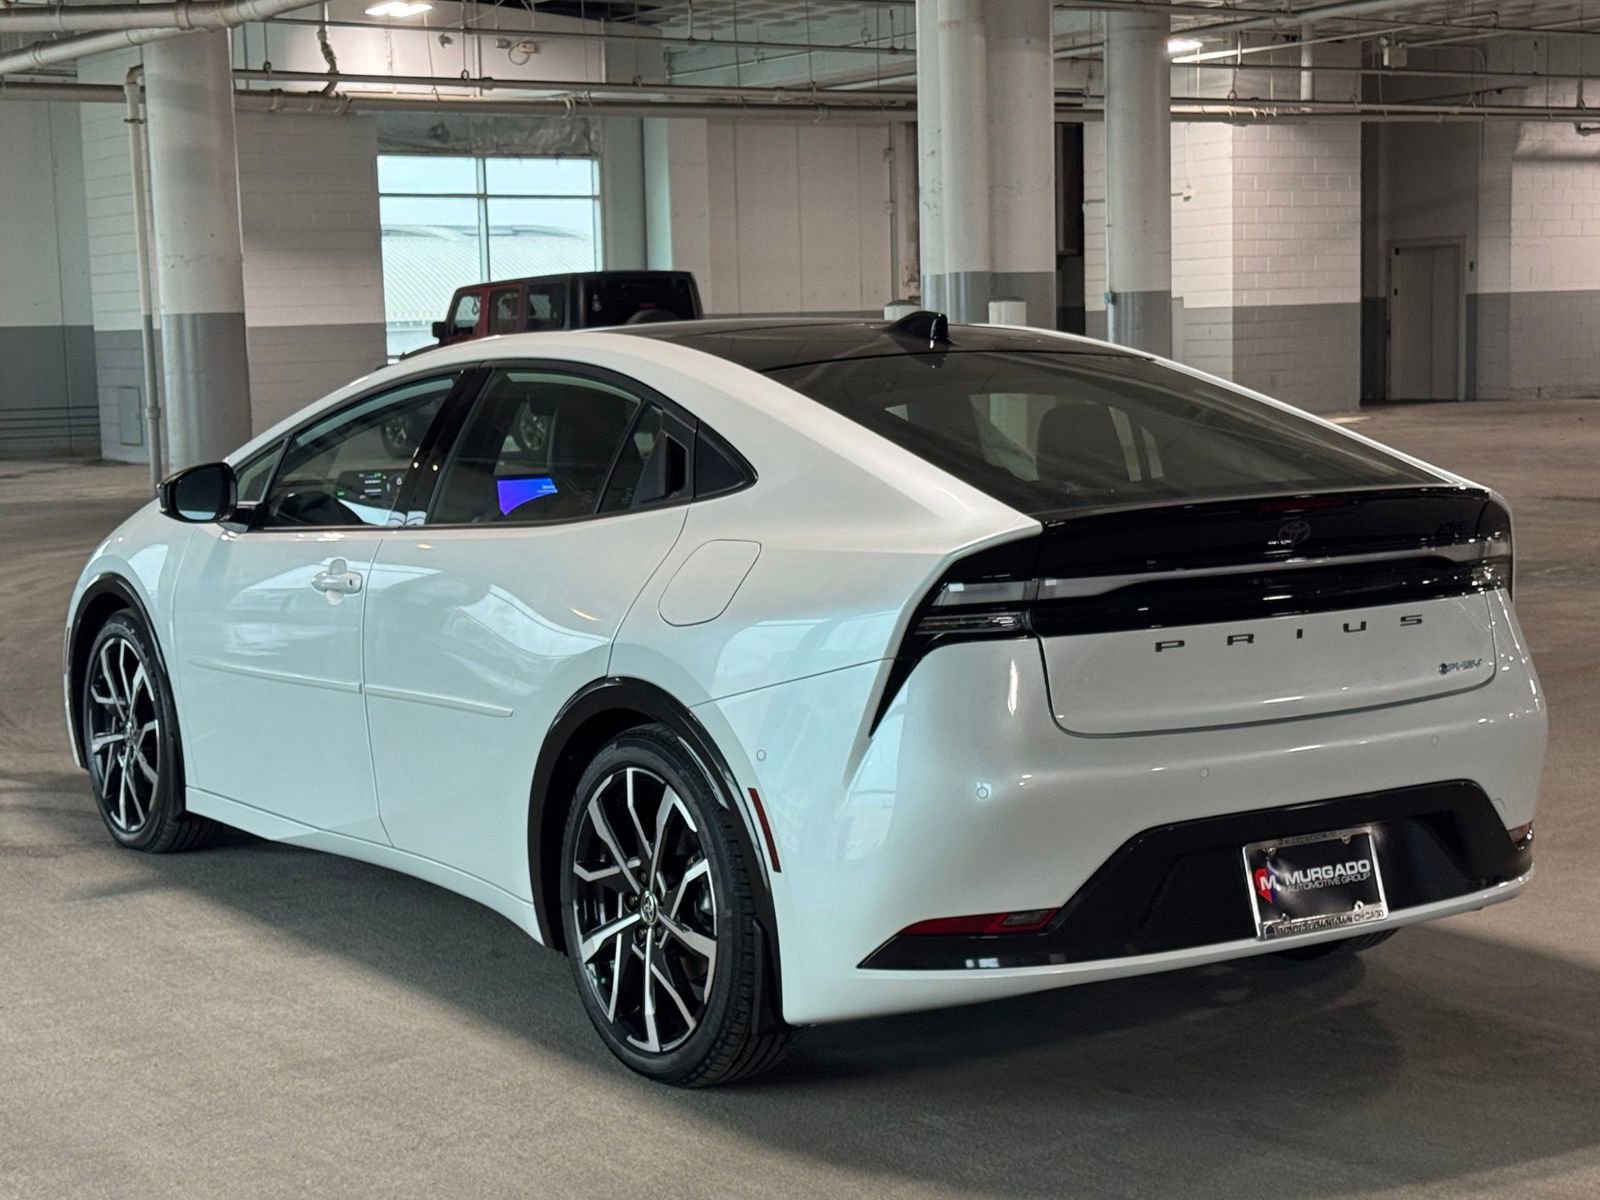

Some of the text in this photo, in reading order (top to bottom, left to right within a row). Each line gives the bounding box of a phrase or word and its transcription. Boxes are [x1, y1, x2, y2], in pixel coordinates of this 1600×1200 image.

[1155, 614, 1423, 652] PRIUS
[1284, 859, 1371, 886] MURGADO
[1287, 872, 1371, 894] AUTOMOTIVE GROUP
